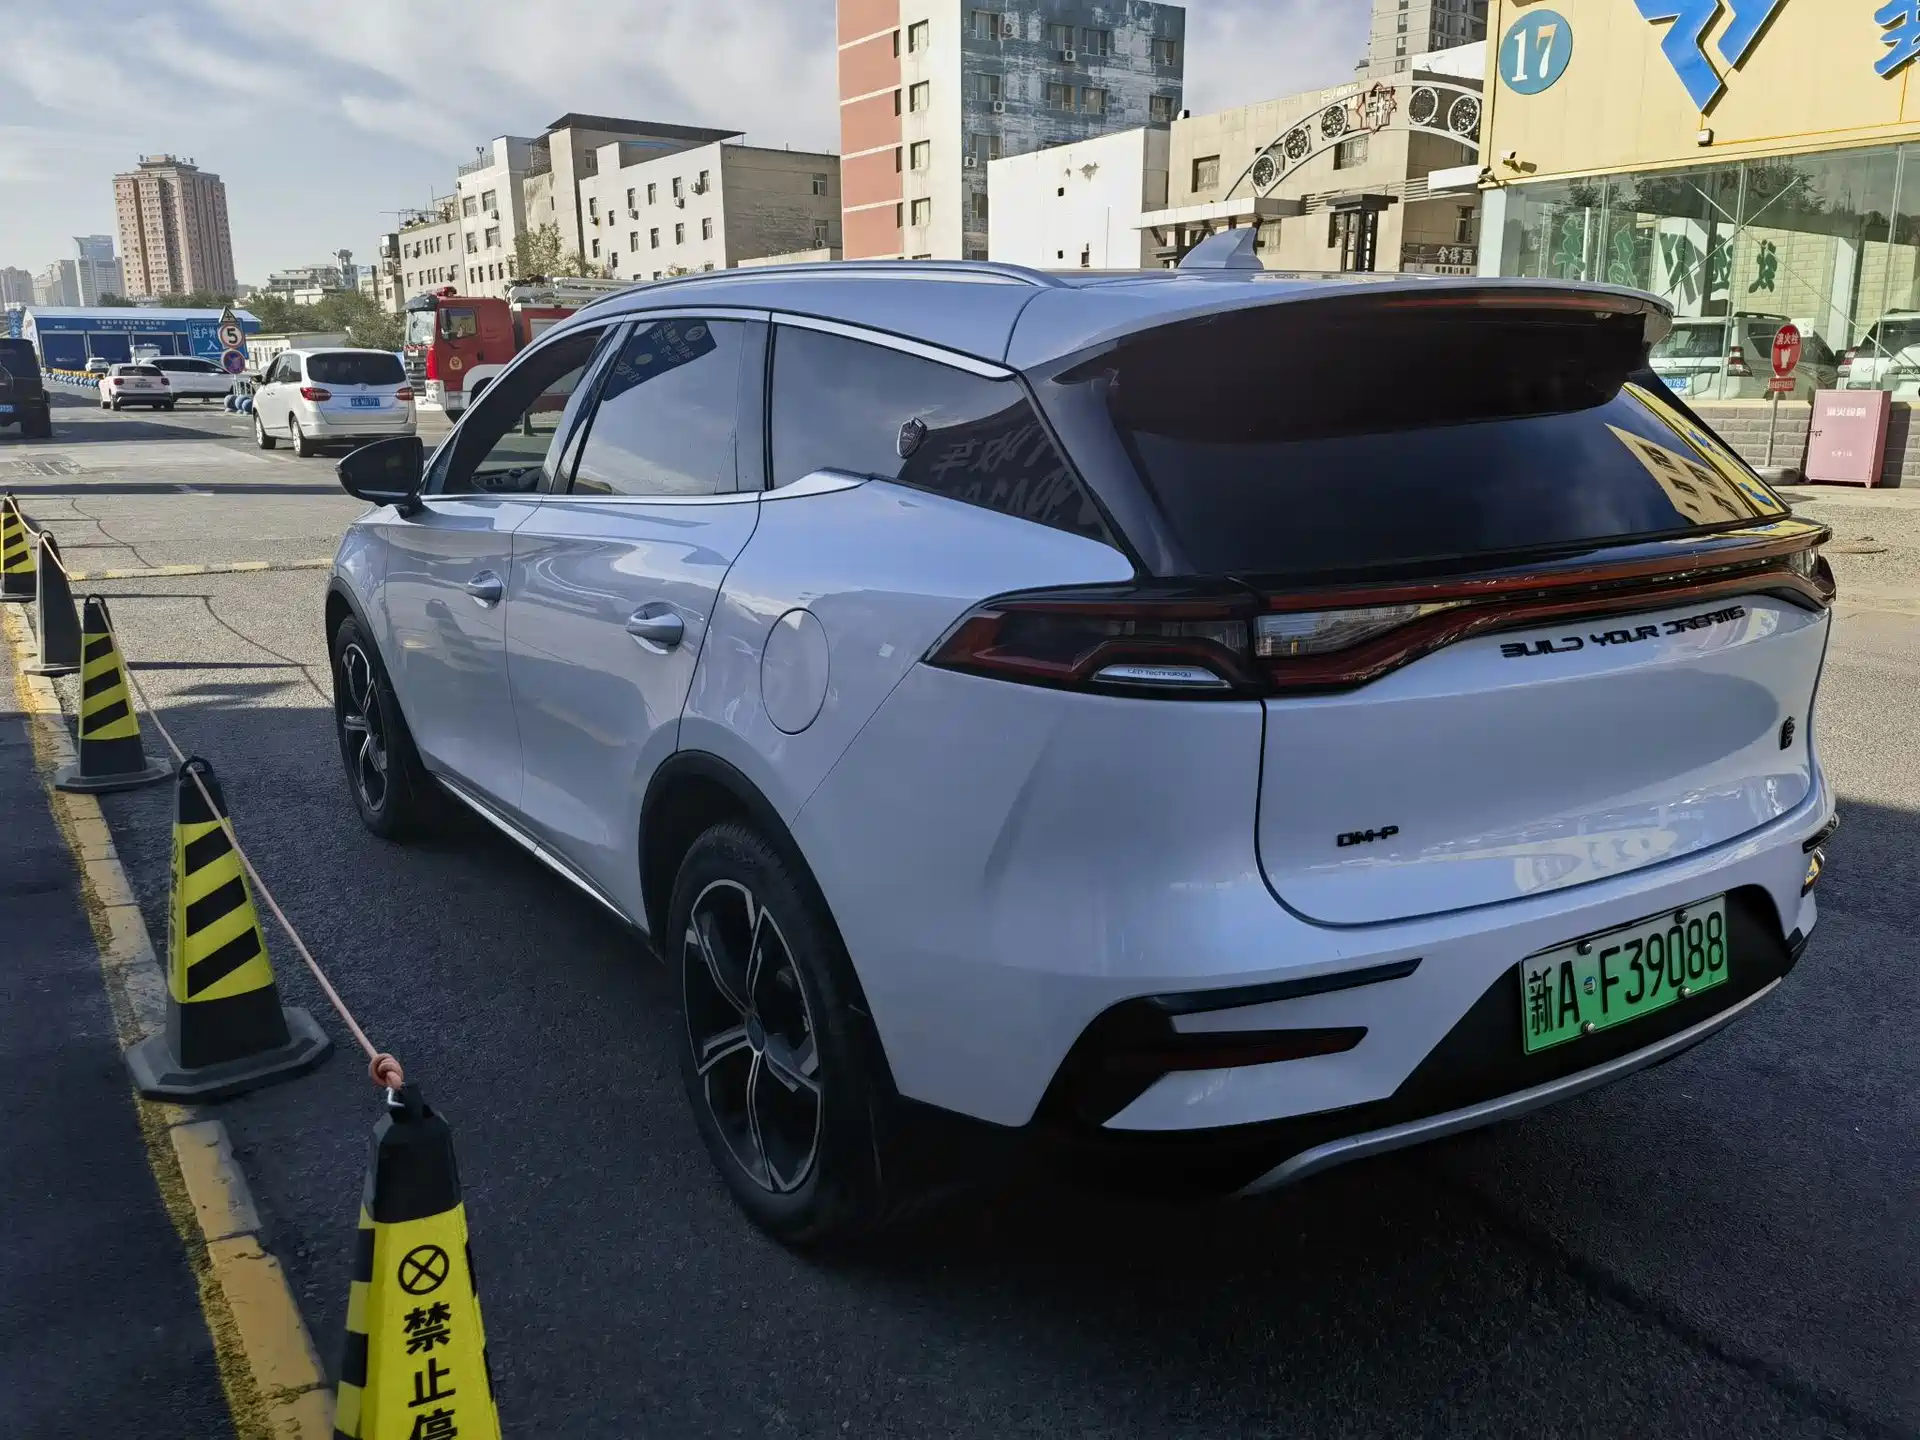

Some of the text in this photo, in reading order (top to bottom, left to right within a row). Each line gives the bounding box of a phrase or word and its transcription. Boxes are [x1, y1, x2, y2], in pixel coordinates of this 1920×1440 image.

[1511, 23, 1558, 82] 17
[1437, 246, 1479, 264] 舍得酒
[226, 327, 238, 344] 5
[1500, 605, 1747, 659] BUILD YOUR DREAMS
[1337, 825, 1399, 848] DM-P
